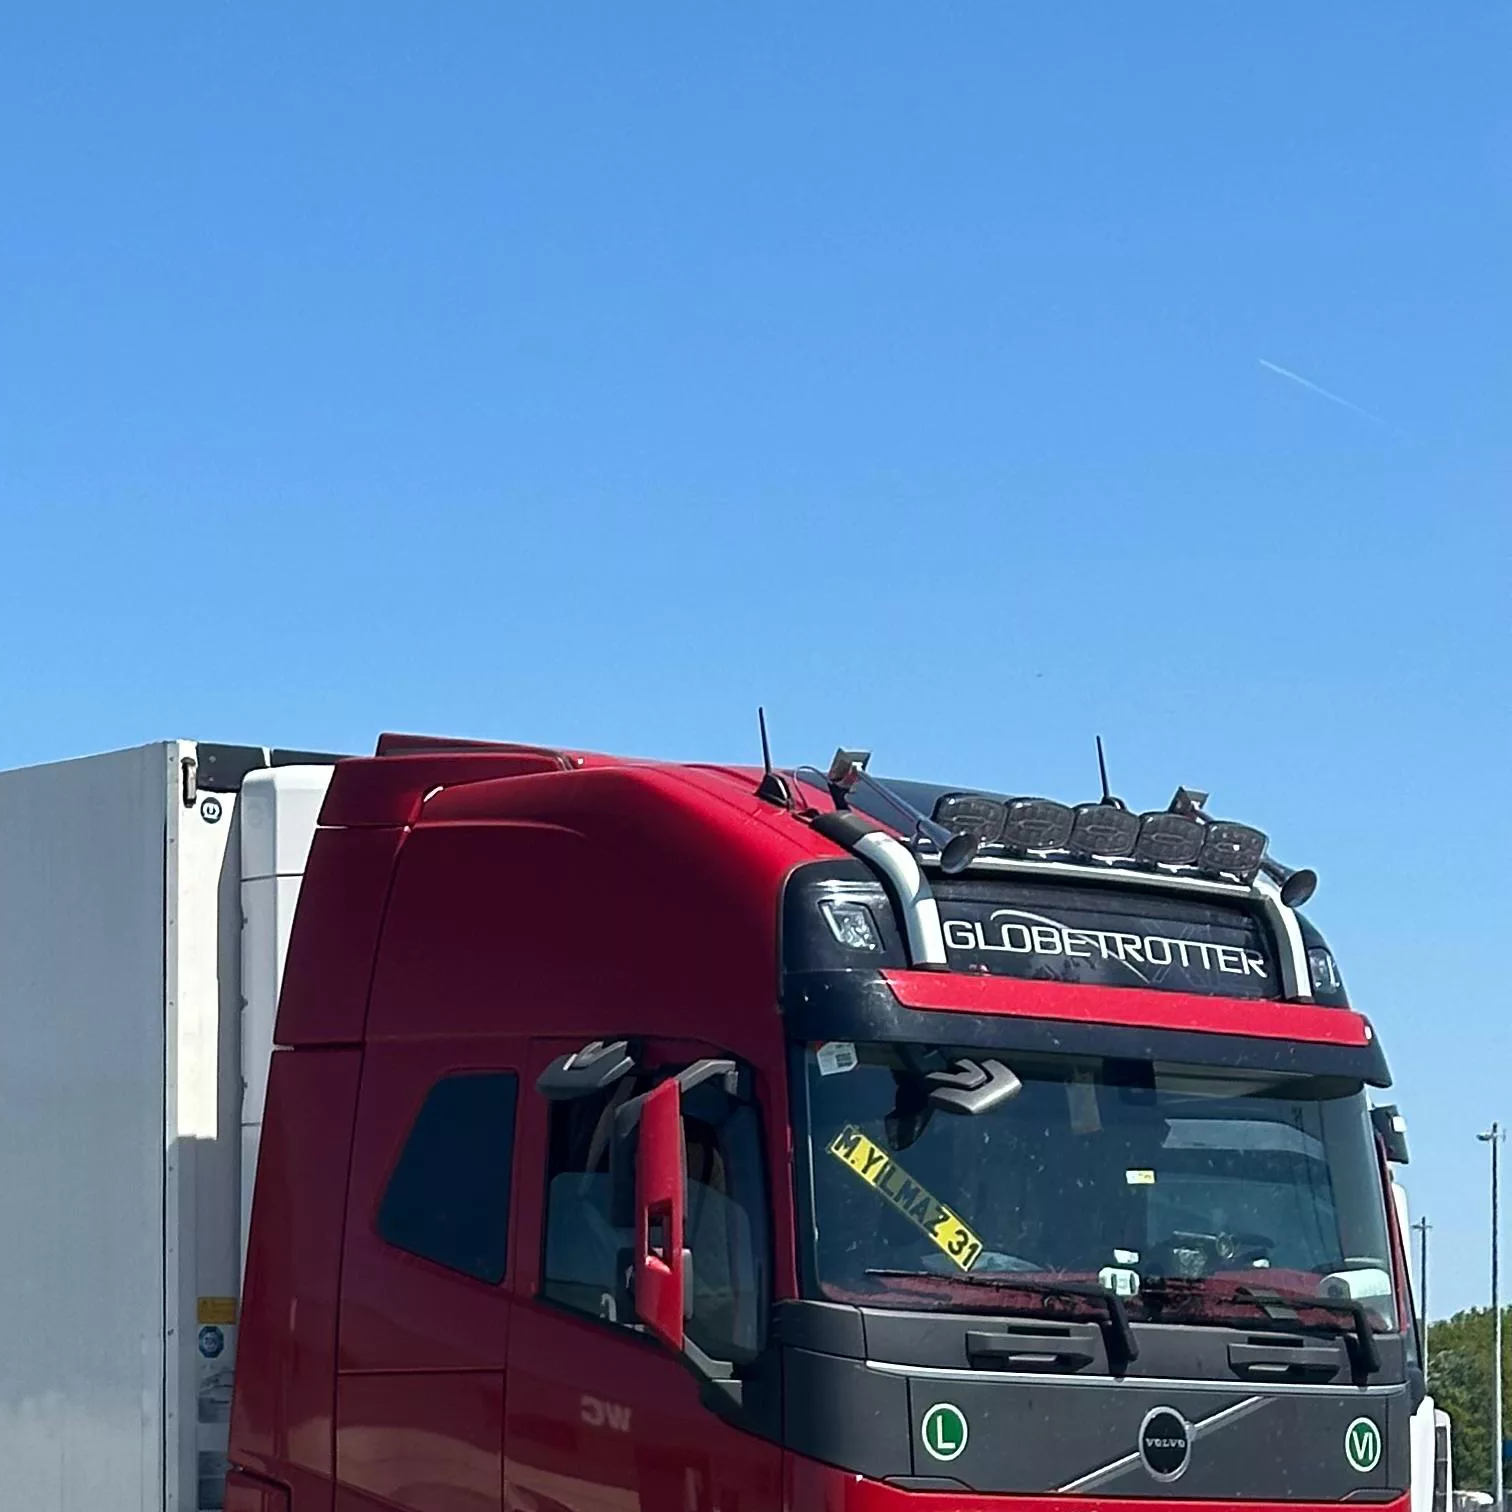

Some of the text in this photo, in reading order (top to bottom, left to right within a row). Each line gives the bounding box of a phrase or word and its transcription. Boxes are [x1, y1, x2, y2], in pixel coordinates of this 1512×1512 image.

[942, 920, 1268, 978] GLOBETROTTER
[947, 1229, 980, 1267] 31
[936, 1414, 956, 1449] L
[1145, 1437, 1186, 1448] VOLVO
